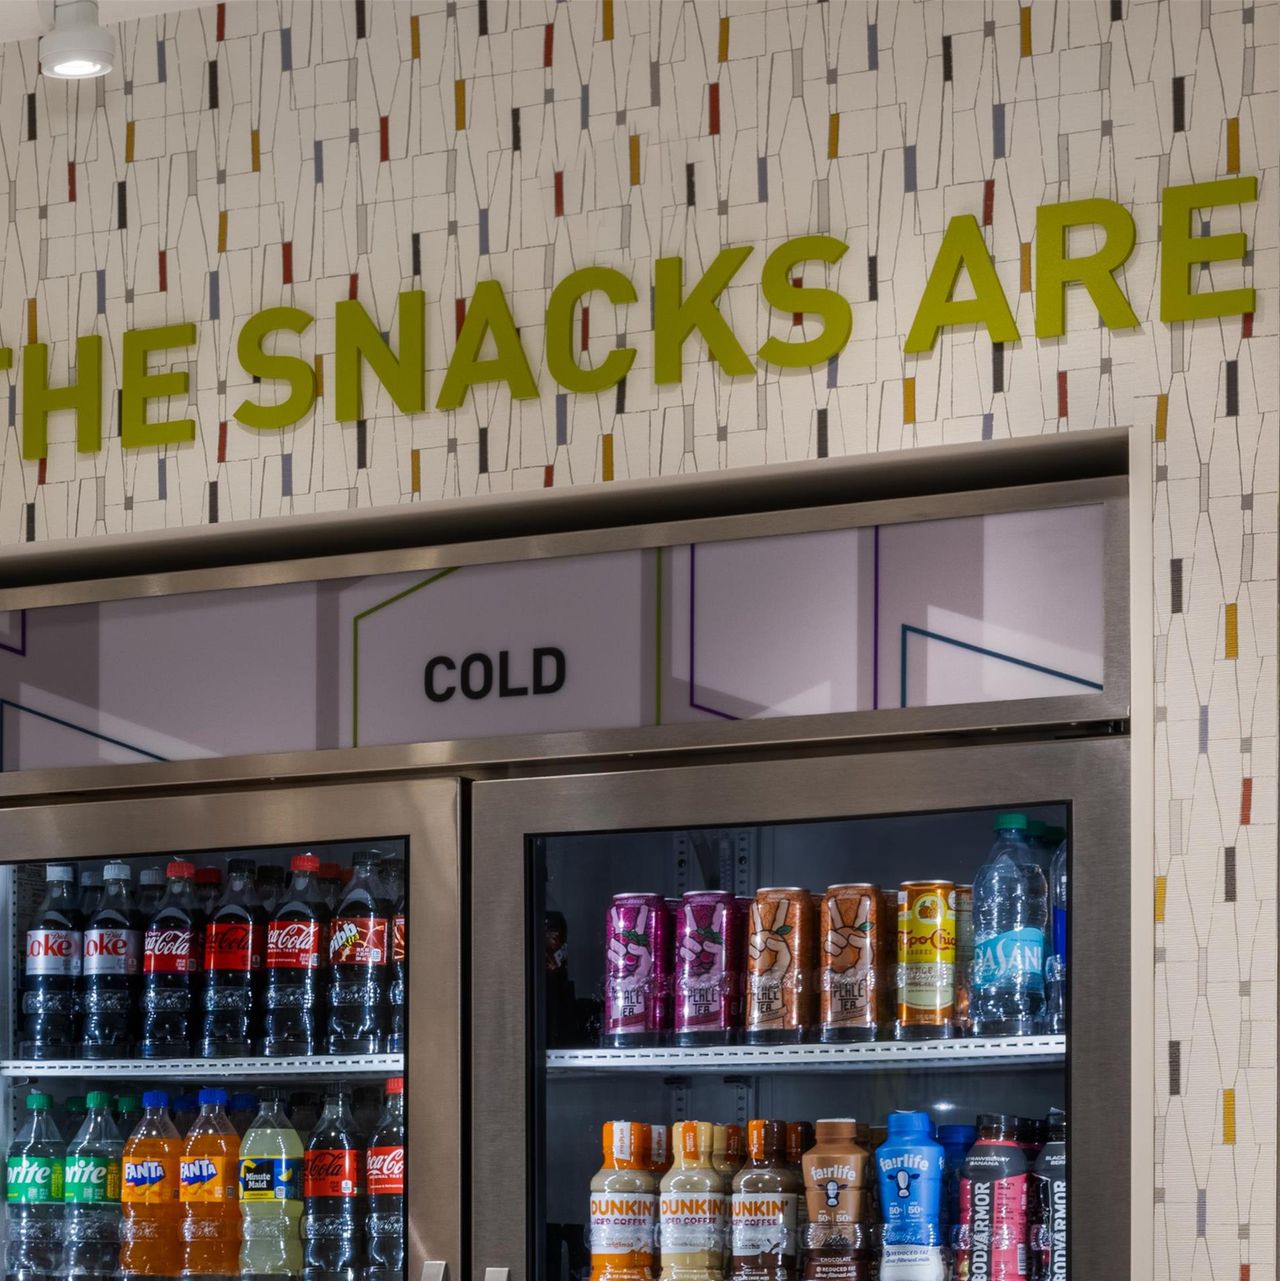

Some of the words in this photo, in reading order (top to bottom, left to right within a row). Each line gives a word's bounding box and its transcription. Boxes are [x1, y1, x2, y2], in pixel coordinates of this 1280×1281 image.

[233, 235, 853, 428] SNACKS
[904, 176, 1259, 354] ARE
[424, 647, 566, 702] COLD
[125, 1160, 165, 1180] FANTA
[245, 1172, 271, 1182] Minute
[249, 1180, 268, 1189] Maid
